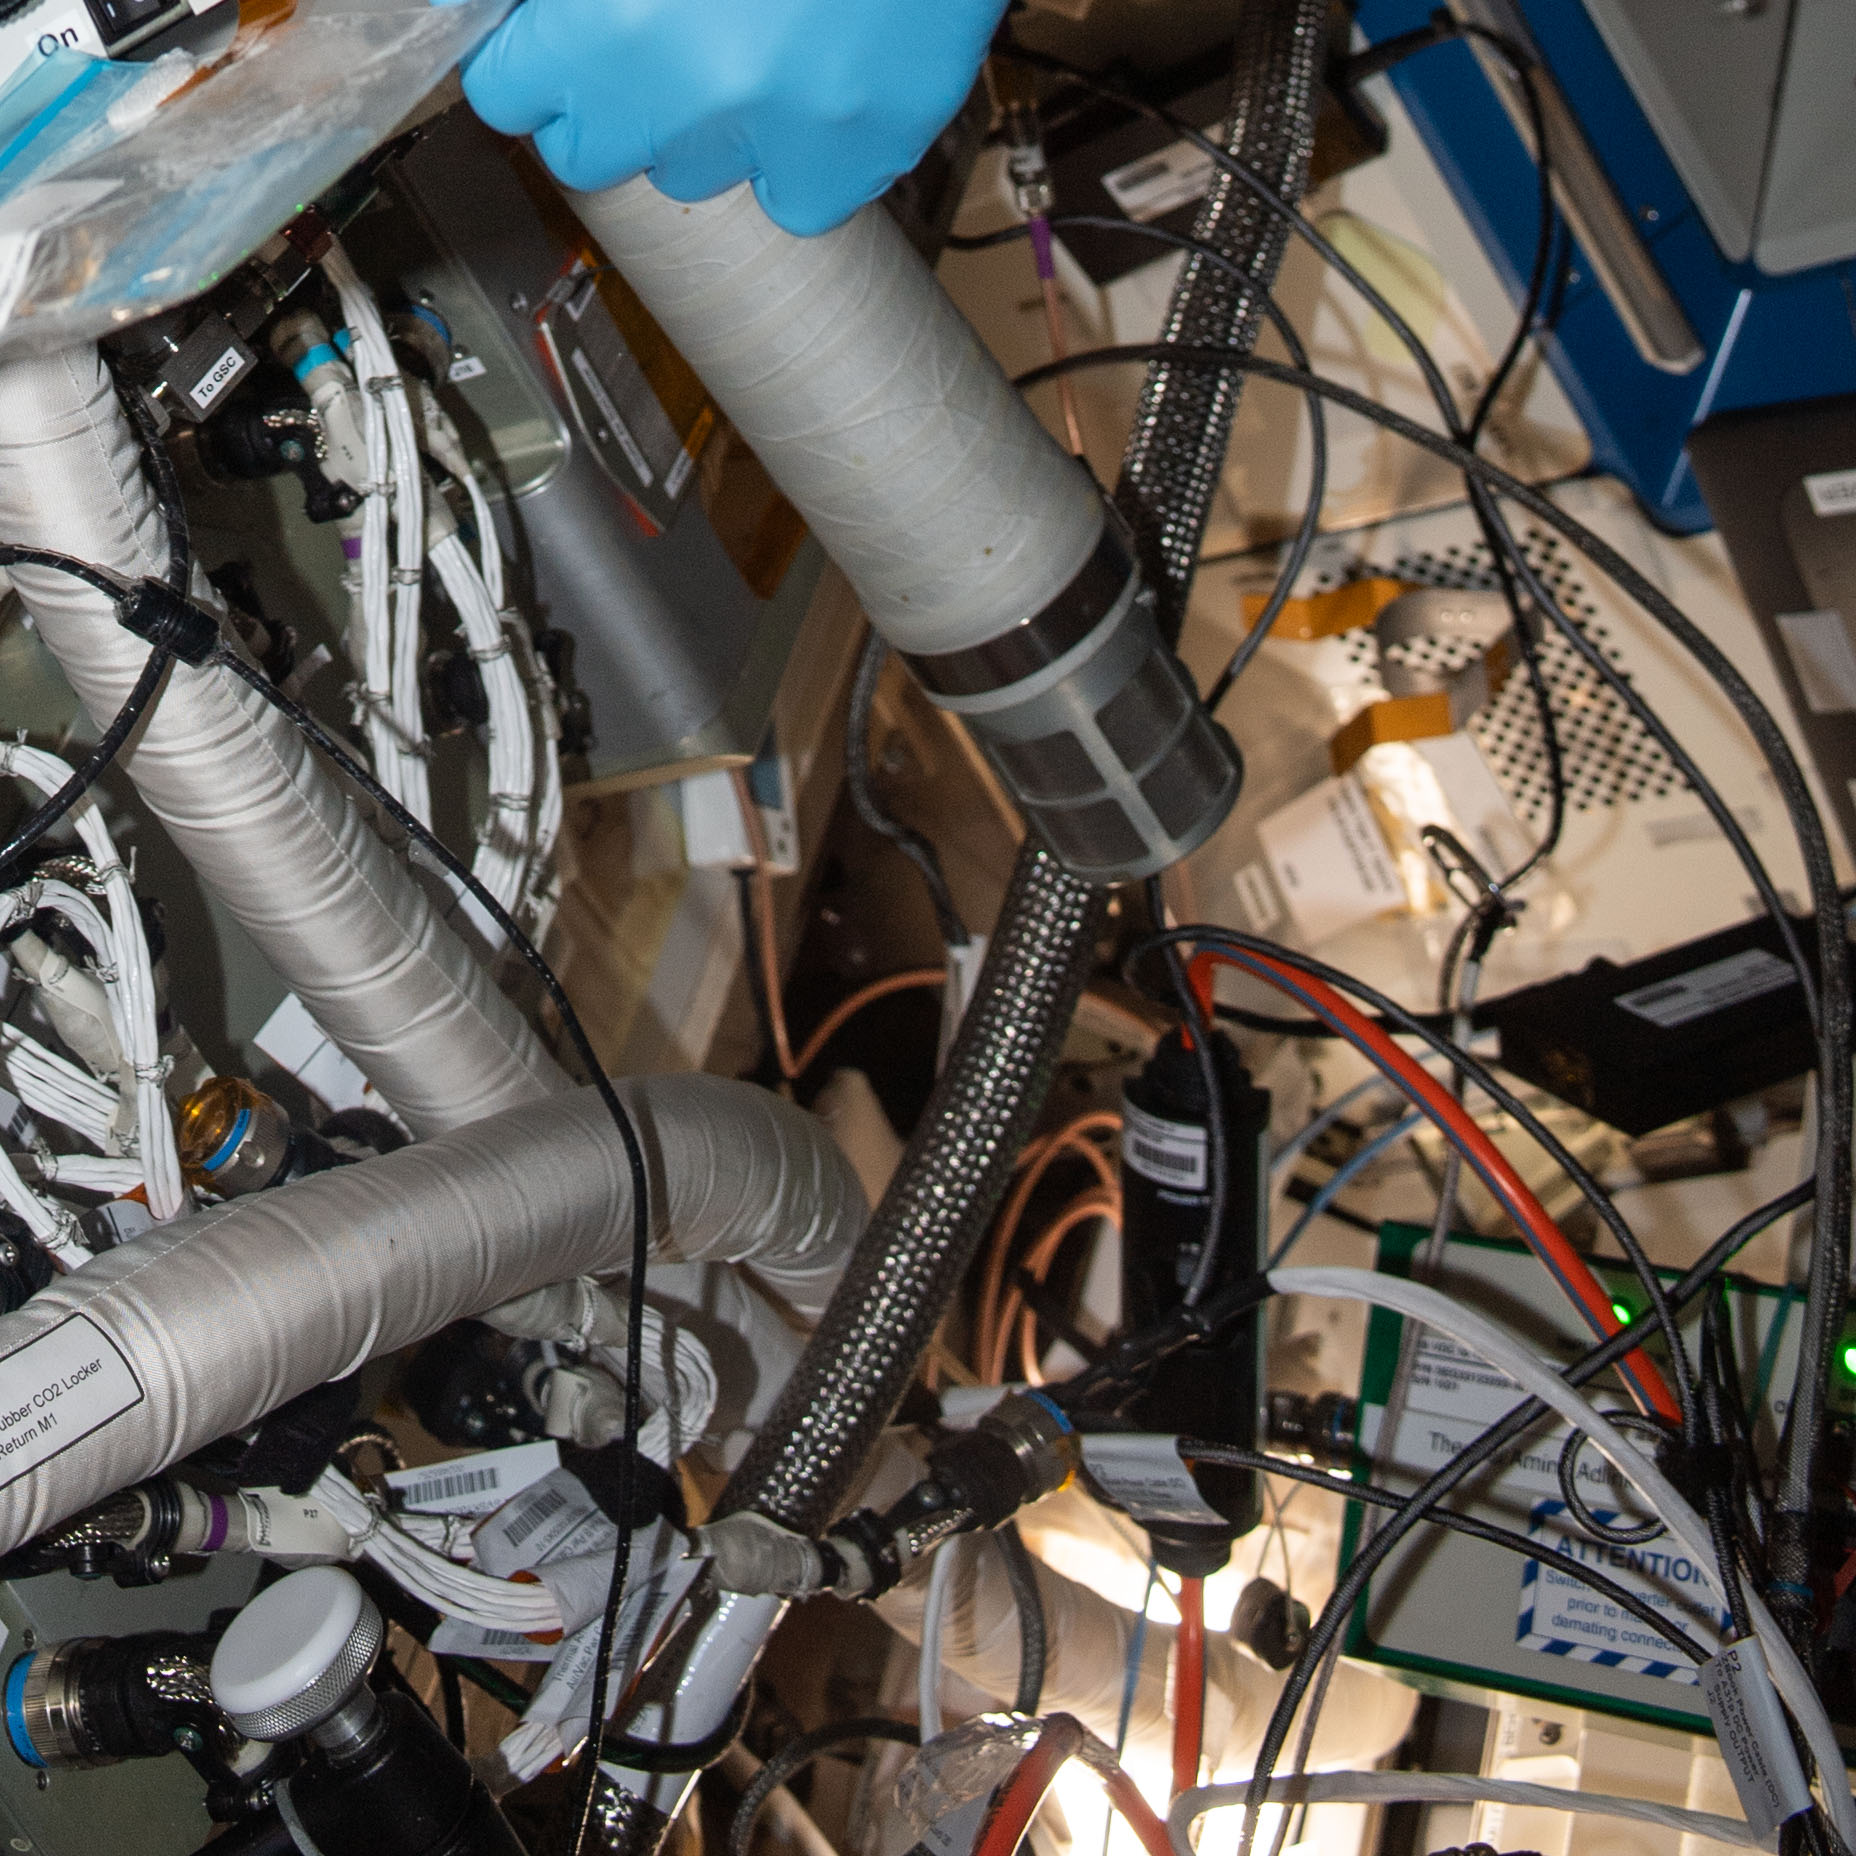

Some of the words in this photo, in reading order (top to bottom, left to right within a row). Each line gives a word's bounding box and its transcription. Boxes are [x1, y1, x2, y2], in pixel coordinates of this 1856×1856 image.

[38, 25, 80, 58] On
[199, 383, 214, 398] To
[211, 355, 238, 385] GSC
[33, 1384, 63, 1407] CO2
[61, 1359, 101, 1389] Locker
[37, 1413, 57, 1432] M1
[1564, 1597, 1599, 1618] prior
[1600, 1604, 1619, 1622] to
[1727, 1649, 1742, 1674] P2
[1709, 1684, 1733, 1726] Supply
[1728, 1727, 1754, 1784] OUTPUT
[1731, 1713, 1745, 1735] DC
[1739, 1735, 1760, 1778] Power
[1734, 1699, 1754, 1738] Power
[1749, 1739, 1768, 1776] Cable
